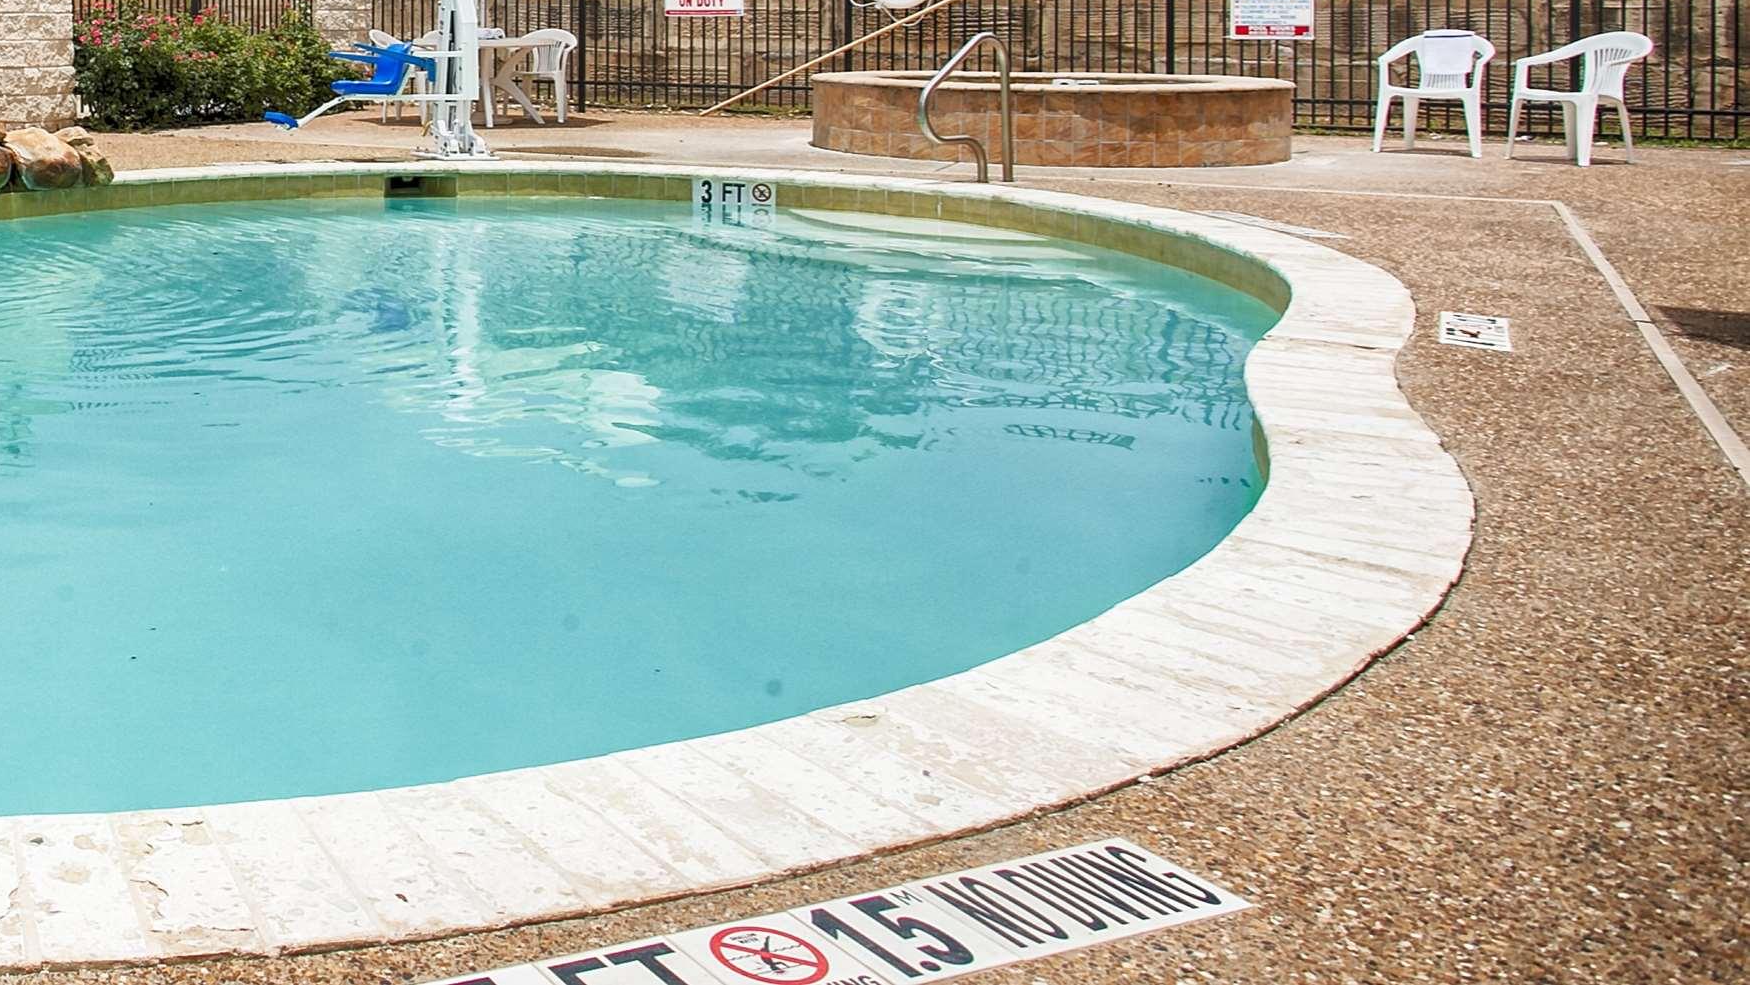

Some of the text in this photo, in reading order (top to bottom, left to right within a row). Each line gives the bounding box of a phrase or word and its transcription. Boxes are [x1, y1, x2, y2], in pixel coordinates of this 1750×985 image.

[701, 180, 745, 203] 3 FT
[922, 876, 1069, 948] NO
[993, 845, 1222, 931] DIVING
[810, 895, 974, 978] 1.5
